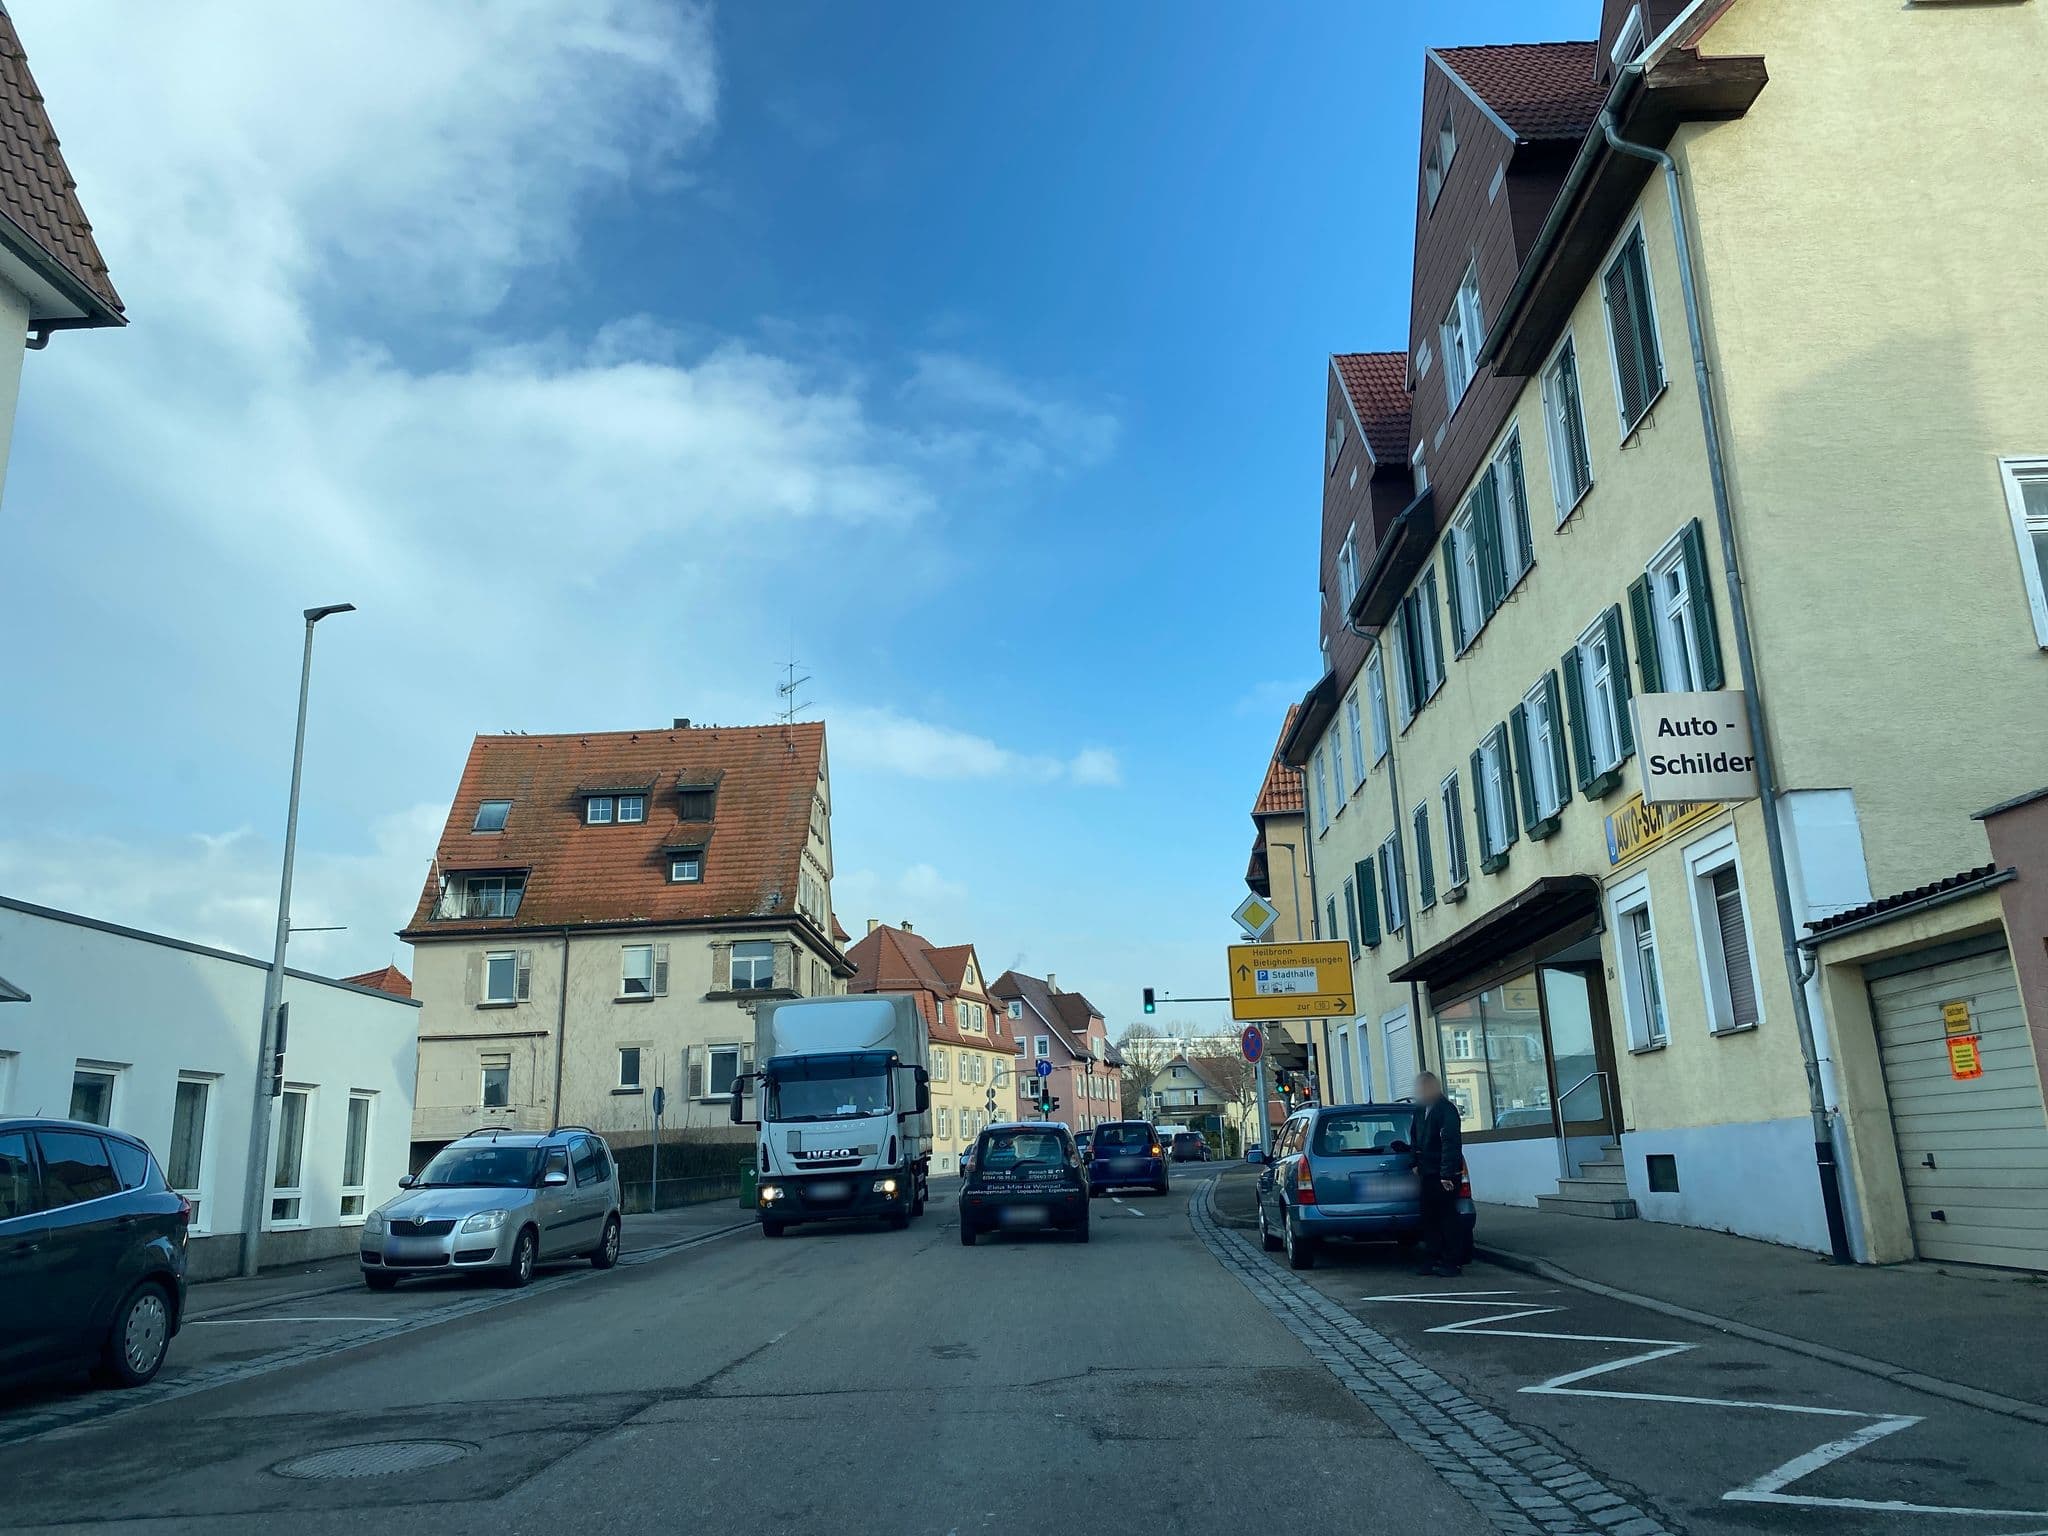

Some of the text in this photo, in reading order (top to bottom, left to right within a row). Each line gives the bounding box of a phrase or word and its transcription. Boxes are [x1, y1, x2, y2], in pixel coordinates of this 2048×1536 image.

[1658, 717, 1718, 737] Auto
[1650, 752, 1755, 775] Schilder
[1252, 948, 1292, 956] Heilbronn
[1254, 956, 1342, 967] Bietigheim-Bissingen
[1272, 970, 1314, 978] Stadthalle
[806, 1149, 850, 1160] IVECO
